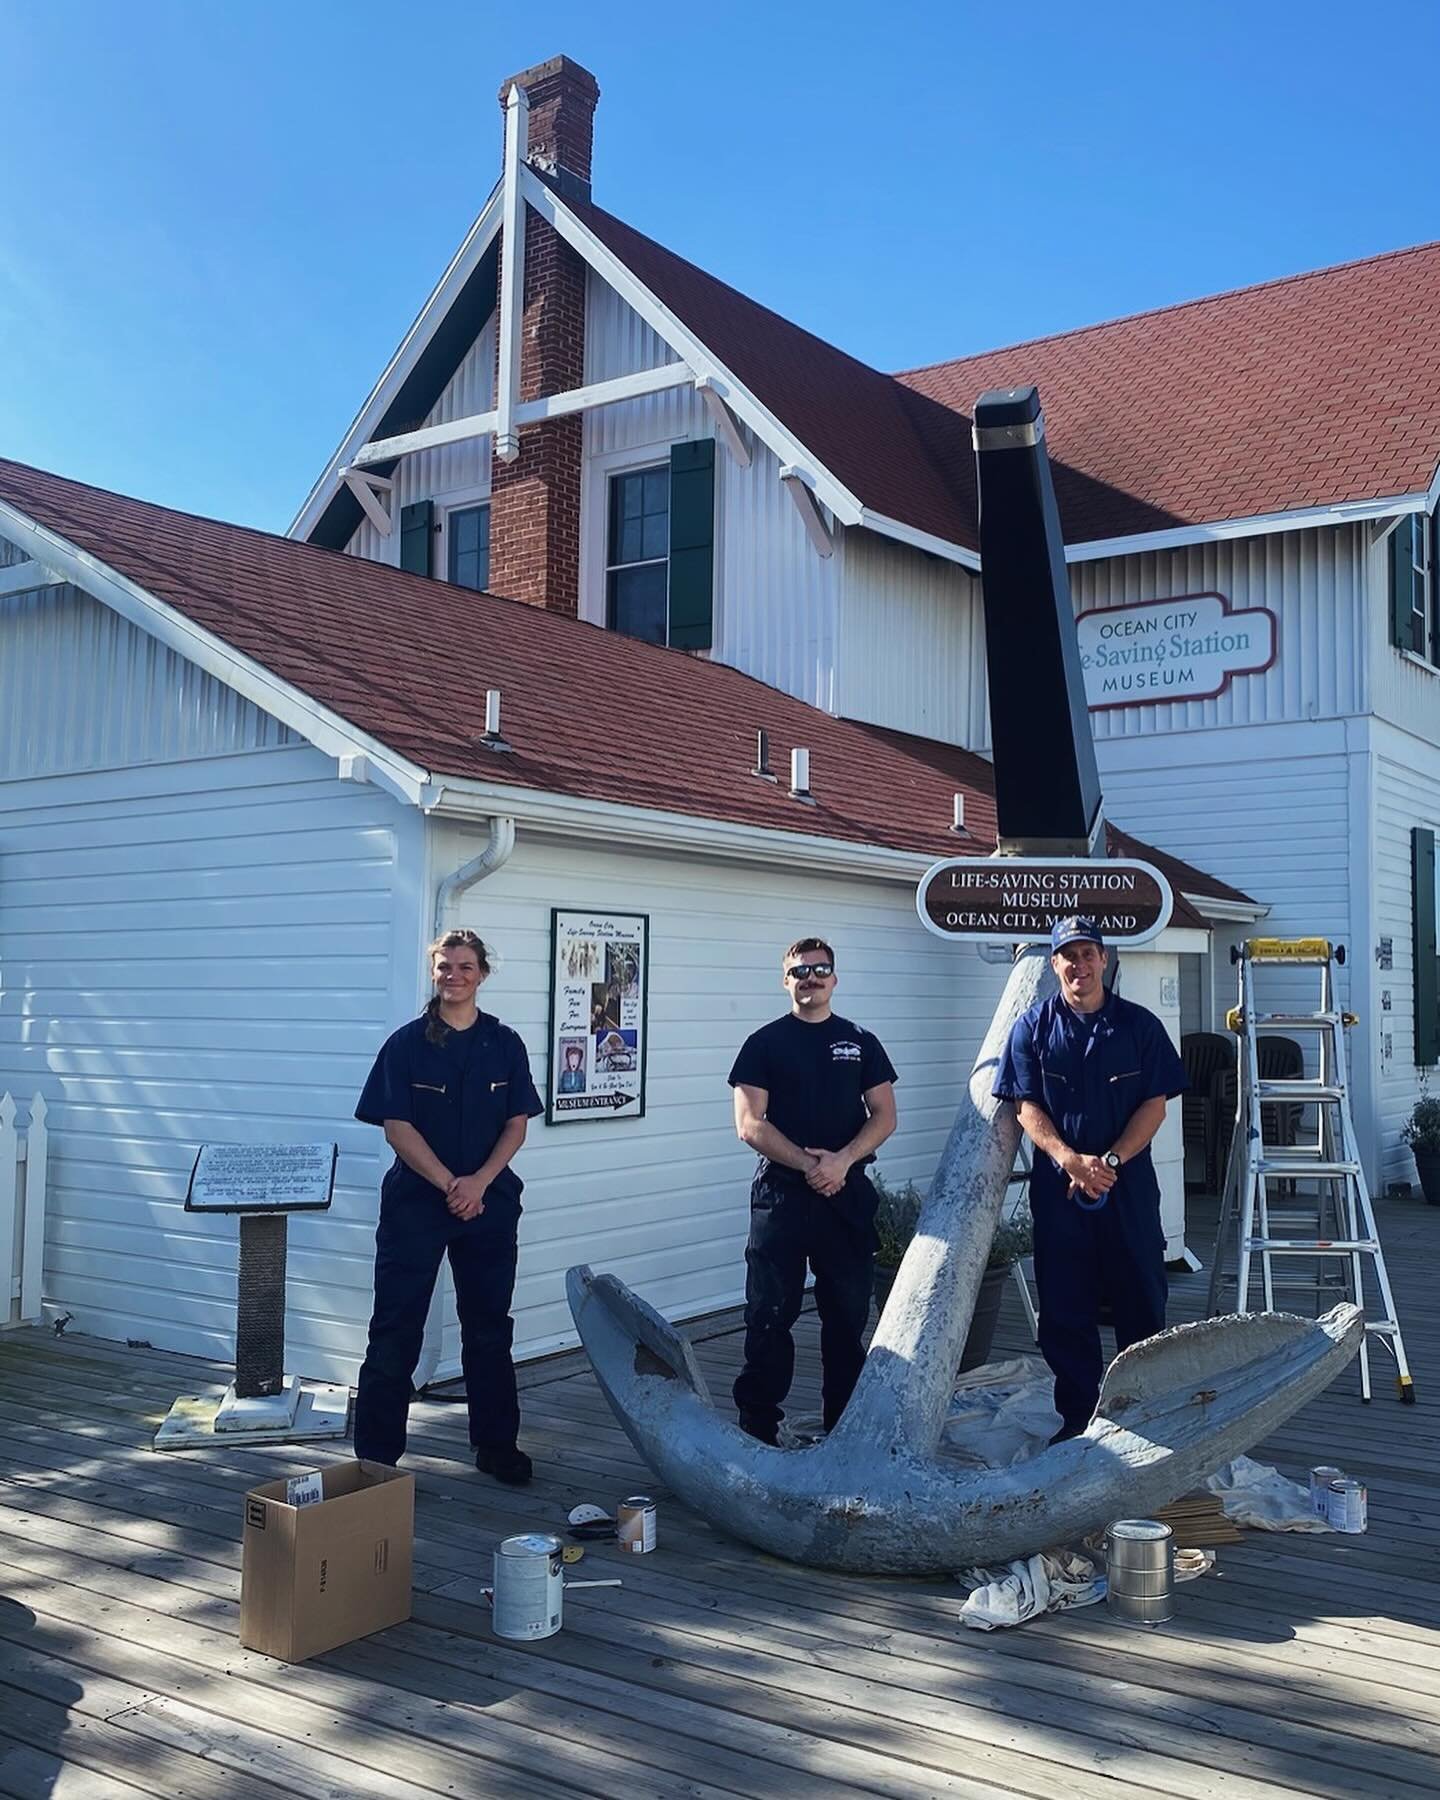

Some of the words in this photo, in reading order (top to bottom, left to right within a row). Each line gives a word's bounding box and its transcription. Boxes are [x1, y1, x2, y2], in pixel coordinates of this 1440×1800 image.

[1100, 617, 1158, 640] OCEAN
[1163, 611, 1198, 631] CITY
[1079, 640, 1167, 670] e-Saving
[1169, 631, 1250, 660] Station
[1102, 668, 1195, 692] MUSEUM
[951, 873, 1055, 889] LIFE-SAVING
[1059, 874, 1136, 890] STATION
[1002, 893, 1079, 908] MUSEUM
[946, 912, 1000, 927] OCEAN
[1003, 913, 1041, 929] CITY,
